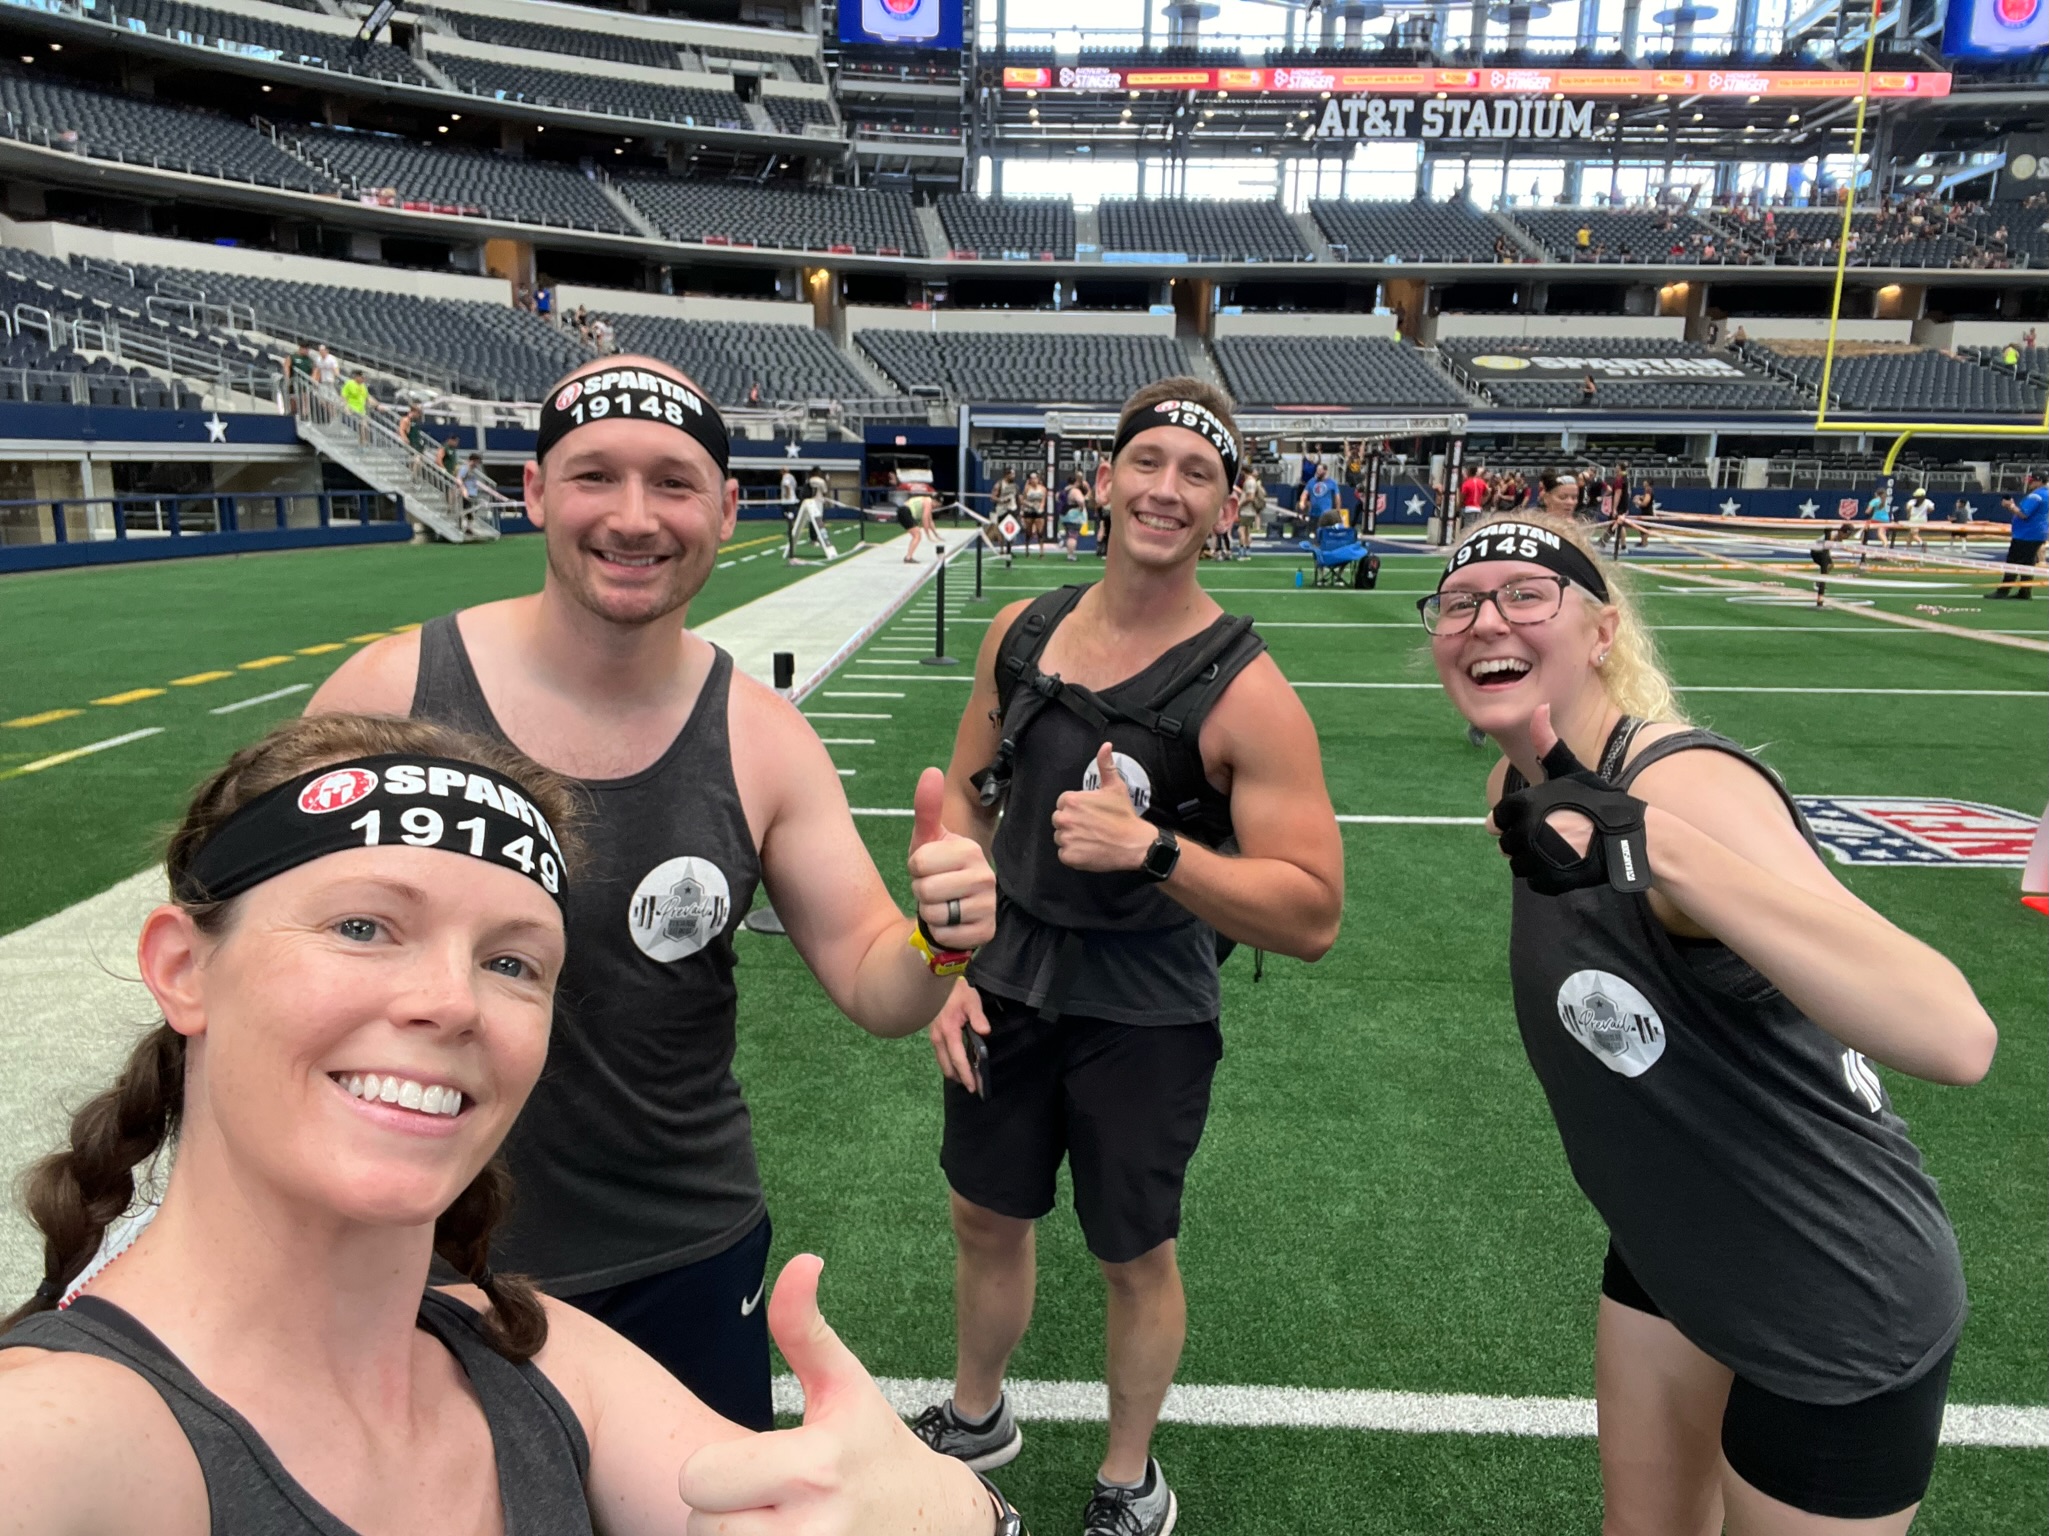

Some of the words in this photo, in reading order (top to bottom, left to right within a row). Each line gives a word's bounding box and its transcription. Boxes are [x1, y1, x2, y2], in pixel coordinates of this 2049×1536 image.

[1073, 73, 1121, 88] STINGER
[1287, 75, 1335, 89] STINGER
[1504, 77, 1551, 90] STINGER
[1721, 79, 1769, 92] STINGER
[1316, 99, 1414, 137] AT&T
[1421, 99, 1595, 138] STADIUM
[571, 393, 684, 426] 19148
[583, 371, 703, 416] SPARTAN
[1168, 410, 1229, 456] 19147
[351, 807, 559, 893] 19149
